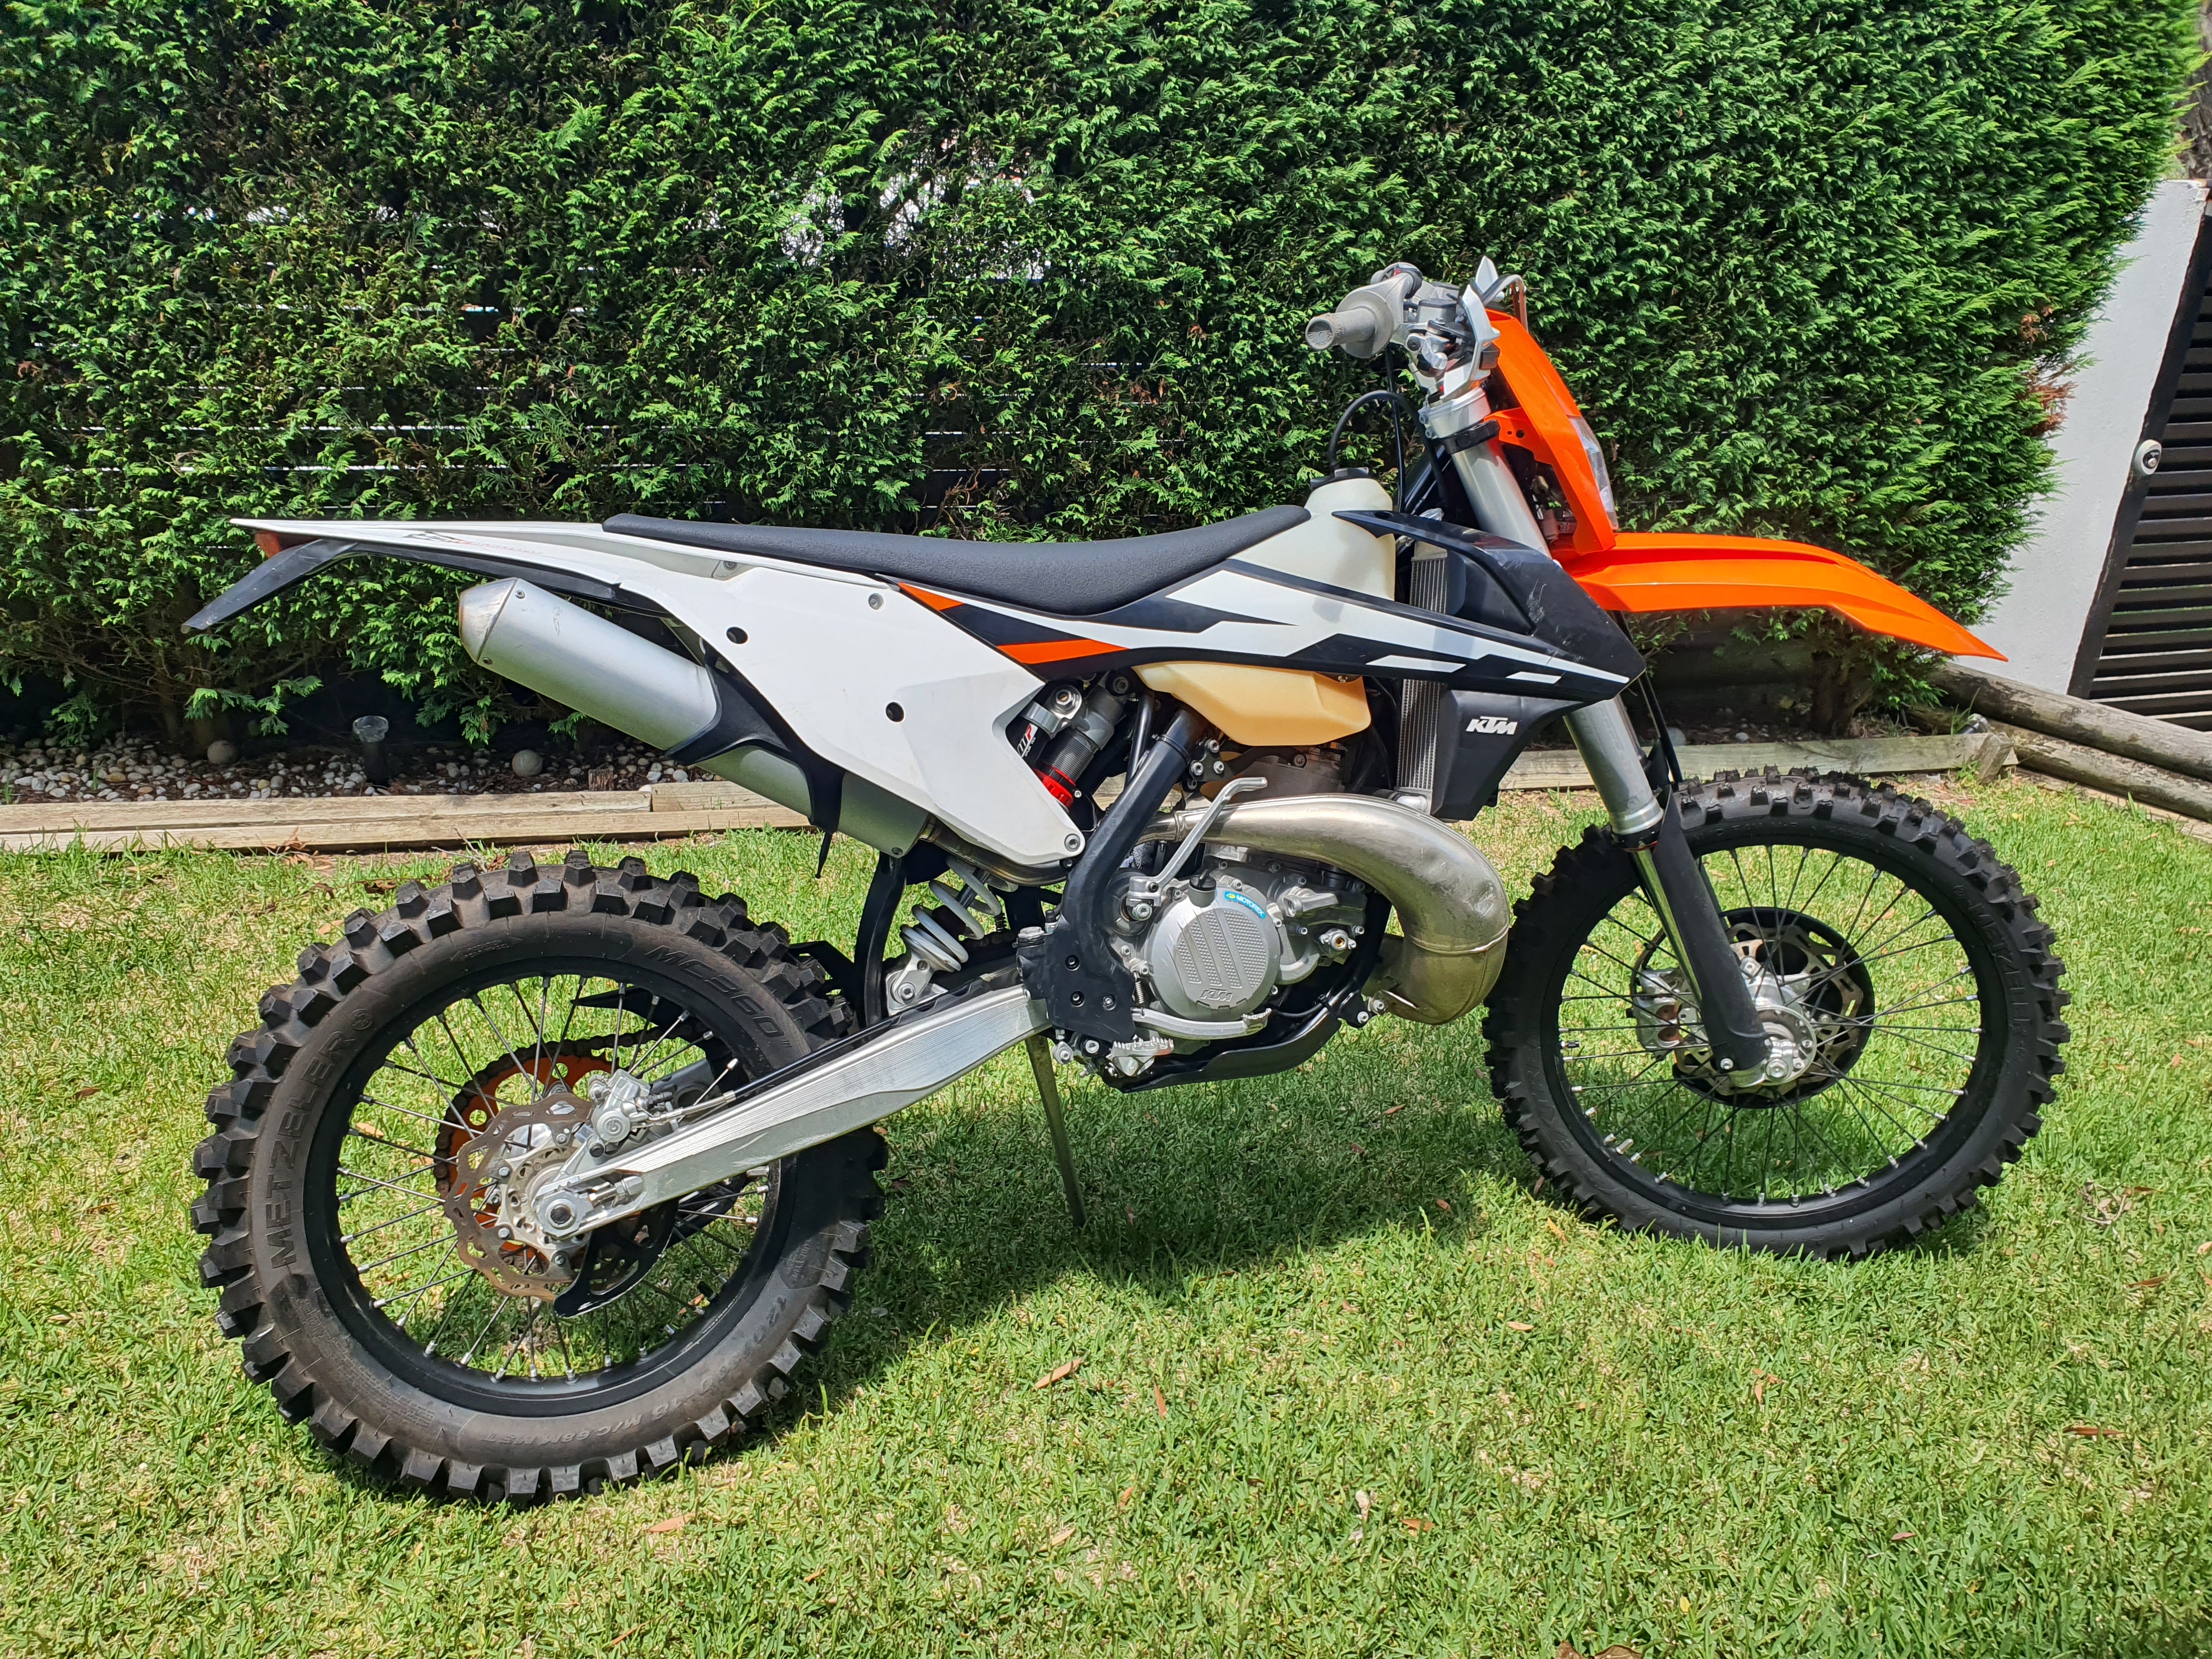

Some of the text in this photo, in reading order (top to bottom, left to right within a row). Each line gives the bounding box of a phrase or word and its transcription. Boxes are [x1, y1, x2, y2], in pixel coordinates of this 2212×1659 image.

[1465, 716, 1518, 735] KTM
[1236, 894, 1264, 917] MOTOREX
[645, 945, 785, 1037] MC360
[1200, 988, 1233, 1002] KTM
[265, 1031, 356, 1269] METZELER
